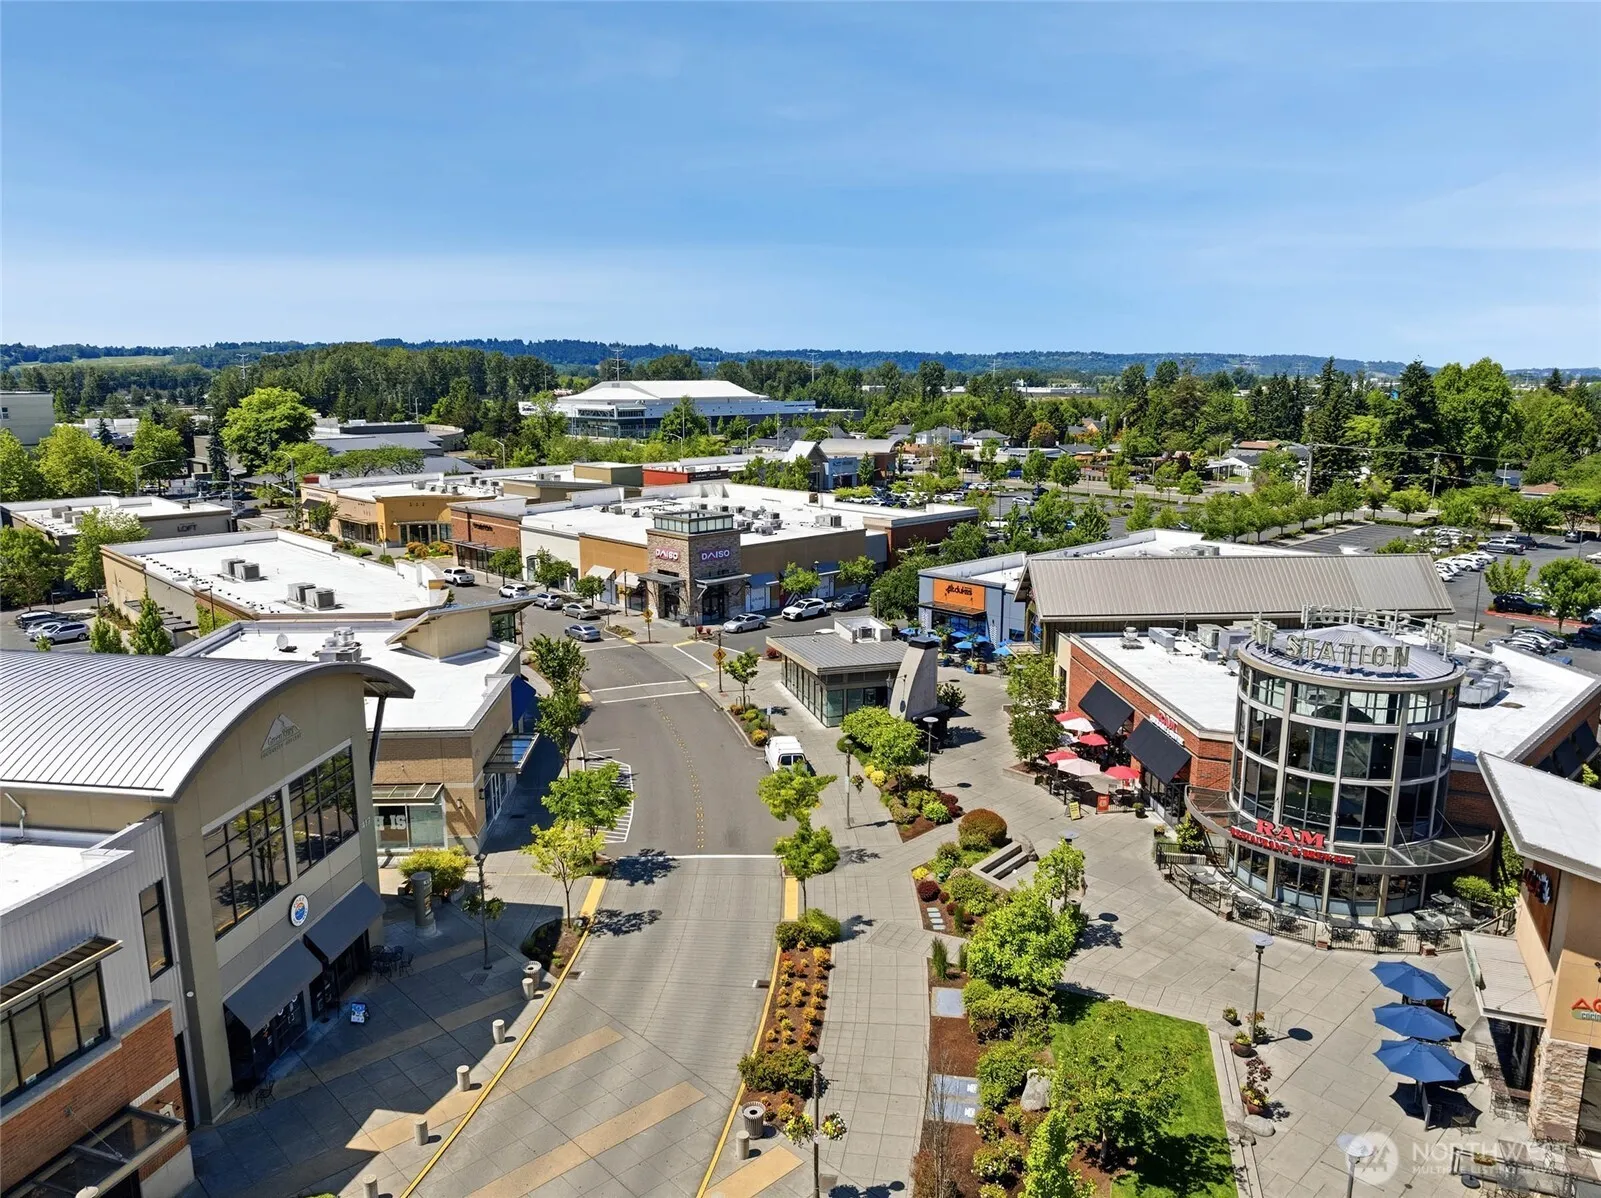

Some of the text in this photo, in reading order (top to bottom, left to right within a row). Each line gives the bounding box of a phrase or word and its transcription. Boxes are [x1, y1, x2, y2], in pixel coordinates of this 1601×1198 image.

[177, 524, 197, 532] LOFT
[655, 548, 679, 560] DAISO
[701, 549, 730, 560] DAISO
[1286, 634, 1411, 667] STATION
[1256, 819, 1326, 849] RAM
